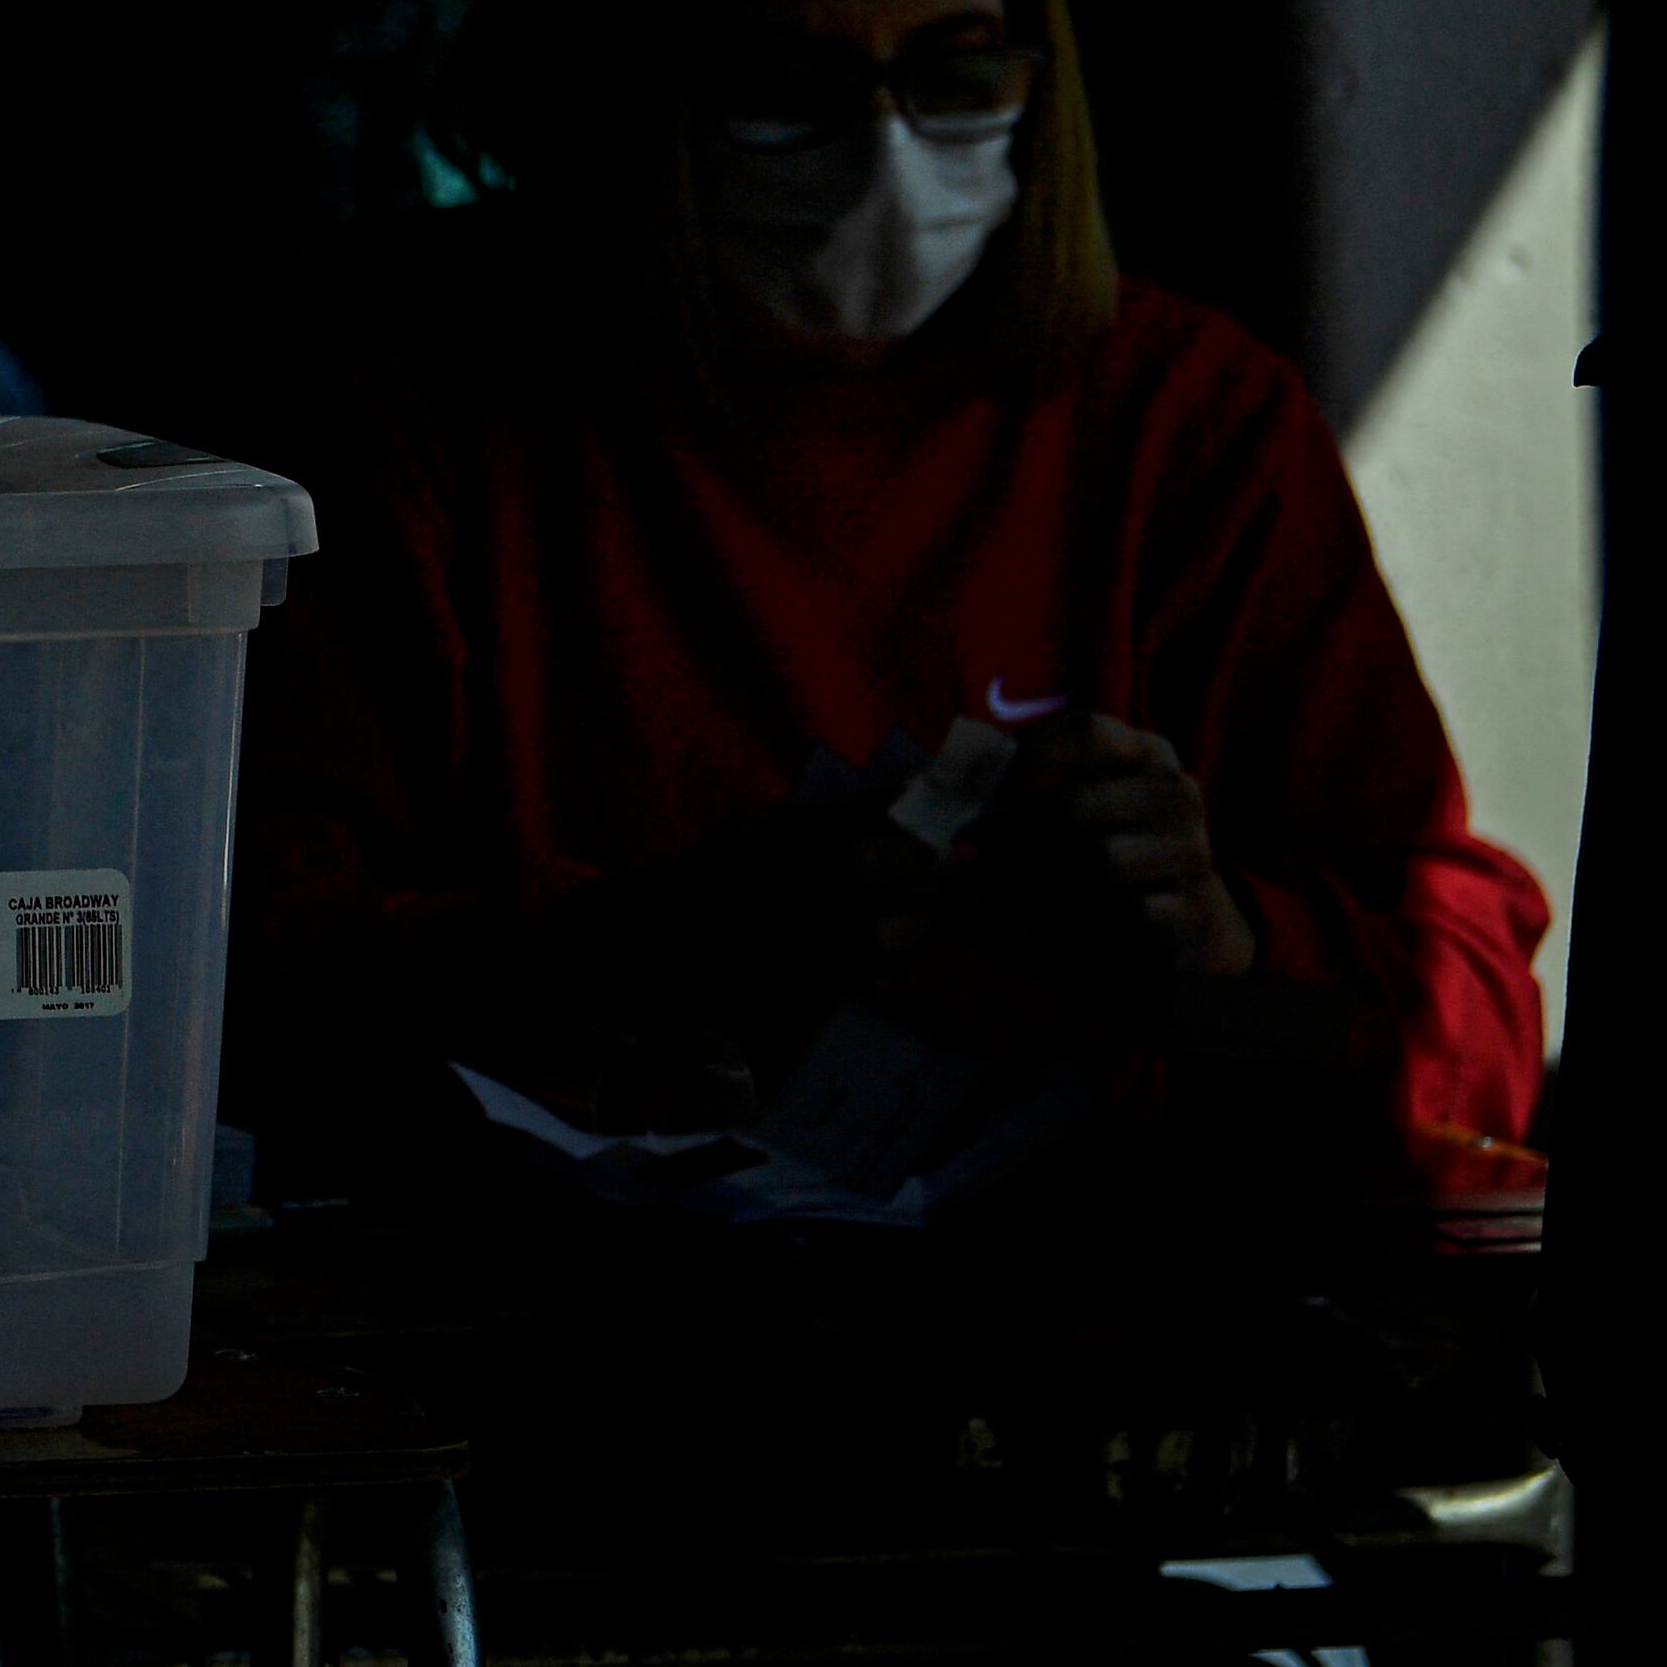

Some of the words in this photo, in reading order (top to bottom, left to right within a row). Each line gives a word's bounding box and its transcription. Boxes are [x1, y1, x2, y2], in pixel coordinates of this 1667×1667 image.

[8, 896, 42, 911] CAJA
[45, 894, 119, 909] BROADWAY
[16, 912, 61, 926] GRANDE
[42, 1002, 69, 1010] MAYO
